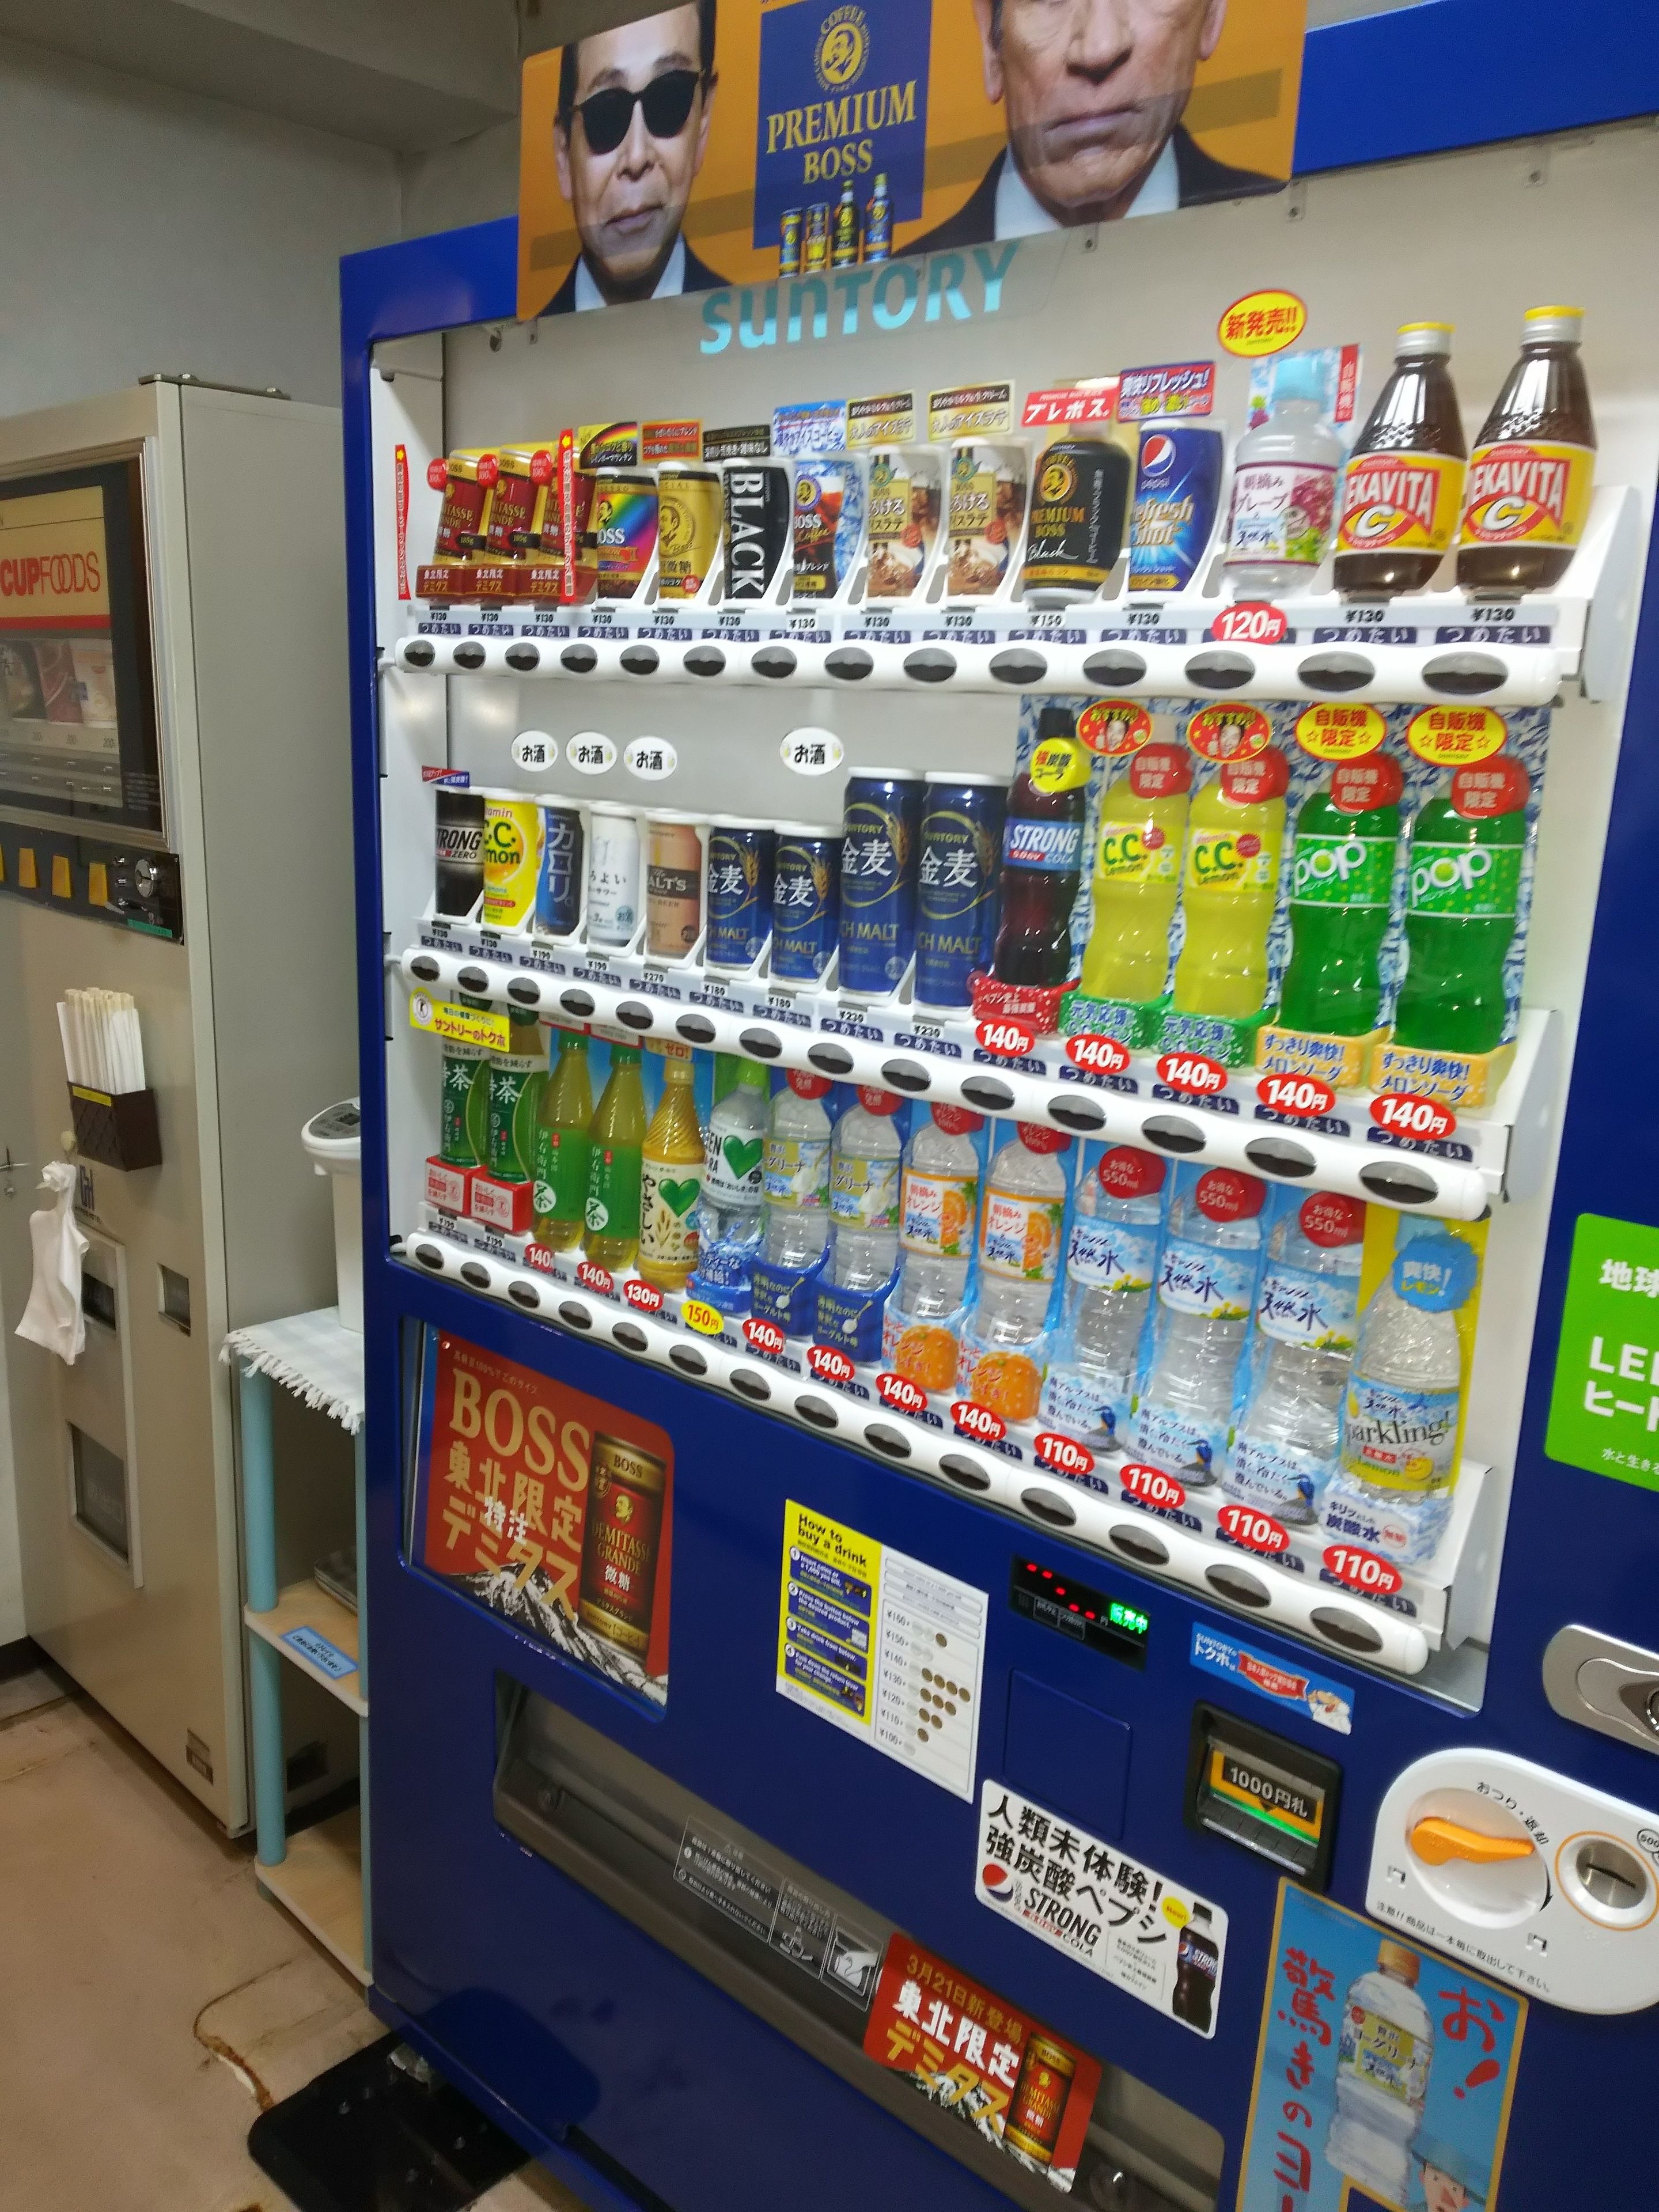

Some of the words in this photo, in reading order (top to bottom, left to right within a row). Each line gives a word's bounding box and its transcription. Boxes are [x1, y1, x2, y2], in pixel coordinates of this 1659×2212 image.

[766, 79, 917, 154] PREMIUM
[803, 140, 873, 184] BOSS
[1225, 307, 1297, 340] 新発売!!
[1025, 397, 1111, 423] プレボス。
[1132, 494, 1195, 525] efresh
[1356, 503, 1394, 538] C
[1482, 496, 1527, 531] C
[730, 470, 766, 597] BLACK
[1027, 539, 1080, 562] Black
[1222, 610, 1281, 639] 120円
[1315, 709, 1368, 727] 自販機
[1428, 712, 1487, 730] 自販機
[521, 745, 546, 763] お酒
[1320, 728, 1357, 748] 限定
[1435, 732, 1474, 752] 限定
[578, 745, 604, 765] お酒
[636, 749, 663, 771] お酒
[794, 743, 825, 766] お酒
[452, 851, 477, 859] ZERO
[1012, 824, 1080, 854] STRONG
[841, 838, 892, 877] 金麦
[919, 846, 979, 888] 金麦
[718, 927, 748, 942] MALT
[785, 940, 818, 954] MALT
[856, 922, 899, 941] MALT
[937, 935, 982, 955] MALT
[434, 1017, 506, 1047] サントリーのトクホ
[983, 1022, 1028, 1056] 140円
[1264, 1032, 1345, 1062] すっきり爽快!
[1073, 1038, 1125, 1071] 140円
[1382, 1051, 1469, 1081] すっきり爽快!
[1165, 1058, 1222, 1090] 140円
[1266, 1079, 1328, 1111] 140円
[1381, 1099, 1449, 1135] 140円
[1103, 1169, 1139, 1188] 550ml
[1199, 1191, 1239, 1212] 550ml
[1304, 1214, 1349, 1237] 550ml
[581, 1264, 612, 1289] 140円
[626, 1283, 660, 1308] 130円
[688, 1304, 719, 1331] 150円
[748, 1322, 783, 1350] 140円
[813, 1349, 851, 1378] 140円
[883, 1376, 923, 1408] 140円
[448, 1368, 590, 1493] BOSS
[957, 1405, 1002, 1437] 140円
[613, 1454, 643, 1479] BOSS
[1043, 1437, 1088, 1472] 110円
[444, 1440, 584, 1553] 東北限定
[1129, 1467, 1180, 1505] 110円
[483, 1495, 529, 1546] 特注
[798, 1513, 826, 1535] How
[830, 1529, 843, 1543] to
[1225, 1509, 1283, 1550] 110円
[1324, 1512, 1381, 1544] 炭酸水
[442, 1497, 579, 1621] デミタス
[597, 1541, 641, 1577] GRANDE
[798, 1525, 820, 1545] buy
[823, 1539, 831, 1550] a
[835, 1544, 867, 1567] drink
[1332, 1549, 1395, 1590] 110円
[1109, 1601, 1149, 1635] 販売中
[1230, 1765, 1309, 1817] 1000円札
[1476, 1781, 1550, 1846] おつり・返却
[988, 1794, 1164, 1914] 人類未体験!
[986, 1824, 1168, 1945] 強炭酸ペプシ
[1025, 1887, 1103, 1948] STRONG
[1062, 1932, 1094, 1958] COLA
[906, 1953, 1024, 2045] 3月21日新登場
[892, 1979, 1020, 2088] 東北限定
[1040, 2046, 1063, 2065] BOSS
[886, 2019, 1009, 2138] デミタス
